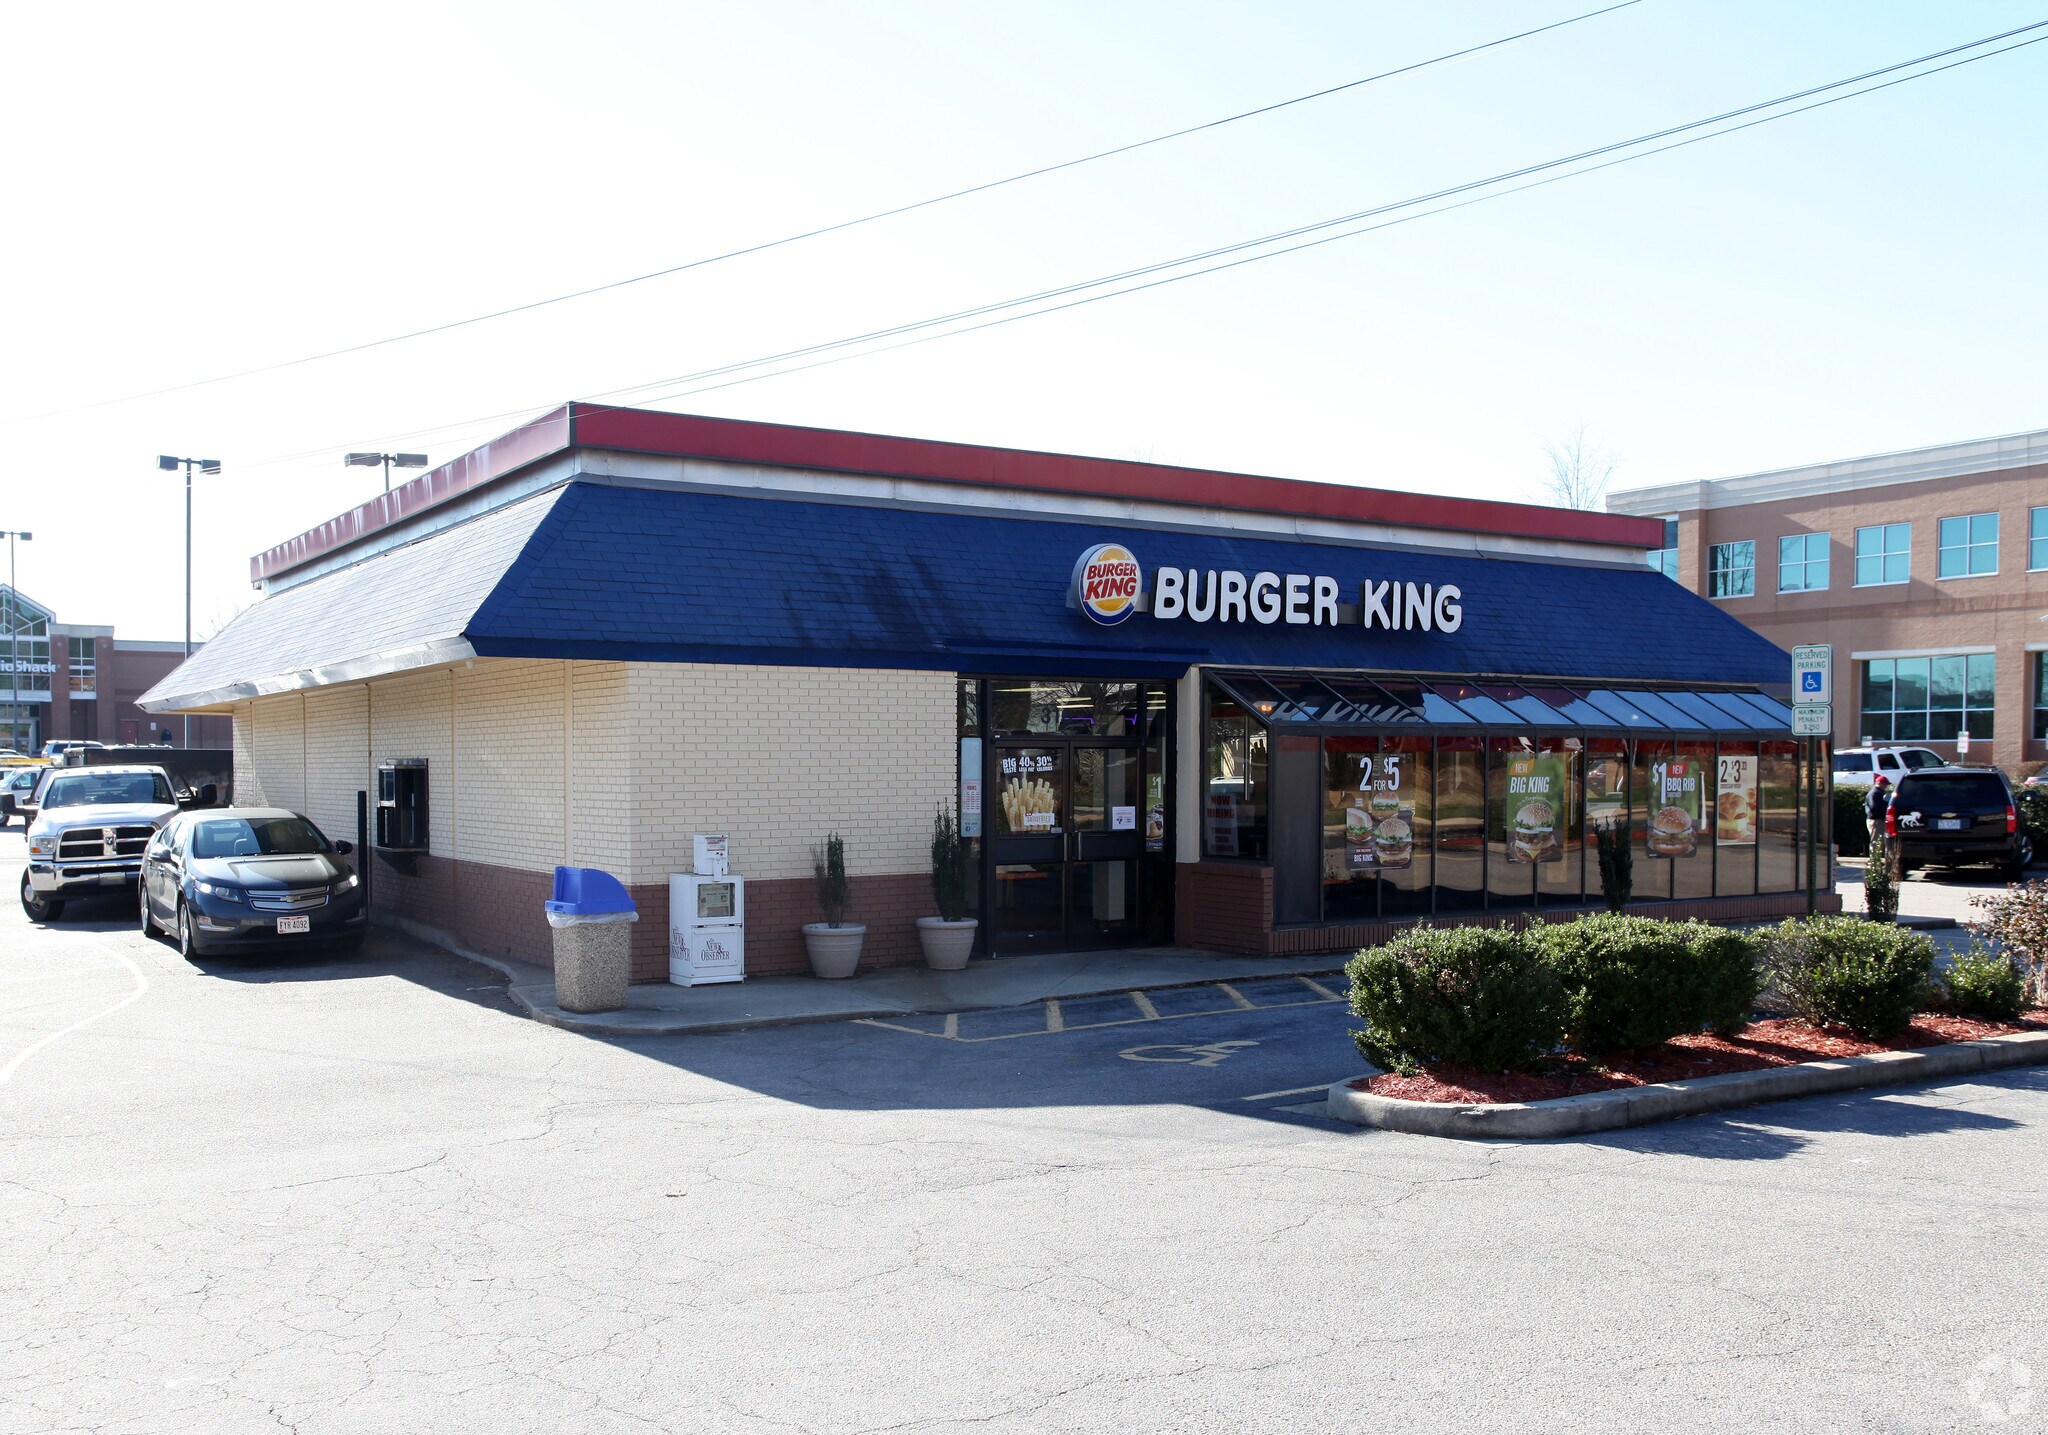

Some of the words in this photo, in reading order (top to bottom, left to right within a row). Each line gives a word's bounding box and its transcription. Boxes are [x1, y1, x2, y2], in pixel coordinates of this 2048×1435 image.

[1087, 563, 1137, 580] BURGER
[1085, 577, 1137, 600] KING
[1153, 566, 1339, 626] BURGER
[1363, 579, 1462, 634] KING
[1795, 650, 1828, 660] RESERVED
[1797, 661, 1826, 669] PARKING
[1002, 757, 1017, 768] BIG
[1019, 756, 1035, 767] 40%
[1036, 756, 1052, 767] 30%
[1515, 763, 1528, 773] NEW
[1360, 757, 1372, 791] 2
[1374, 780, 1386, 791] FOR
[1384, 757, 1400, 791] $5
[1672, 764, 1684, 774] NEW
[1720, 760, 1728, 783] 2
[1152, 776, 1161, 798] $1
[1510, 777, 1526, 793] BIG
[1528, 777, 1550, 793] KING
[1652, 762, 1667, 803] $1
[1667, 778, 1682, 792] BBQ
[1682, 778, 1695, 792] RIB
[1211, 795, 1231, 805] NOW
[1206, 808, 1235, 818] HIRING
[1362, 854, 1373, 862] KING
[279, 922, 291, 930] FYR
[293, 920, 308, 929] 4092
[701, 950, 730, 961] OBSERVER
